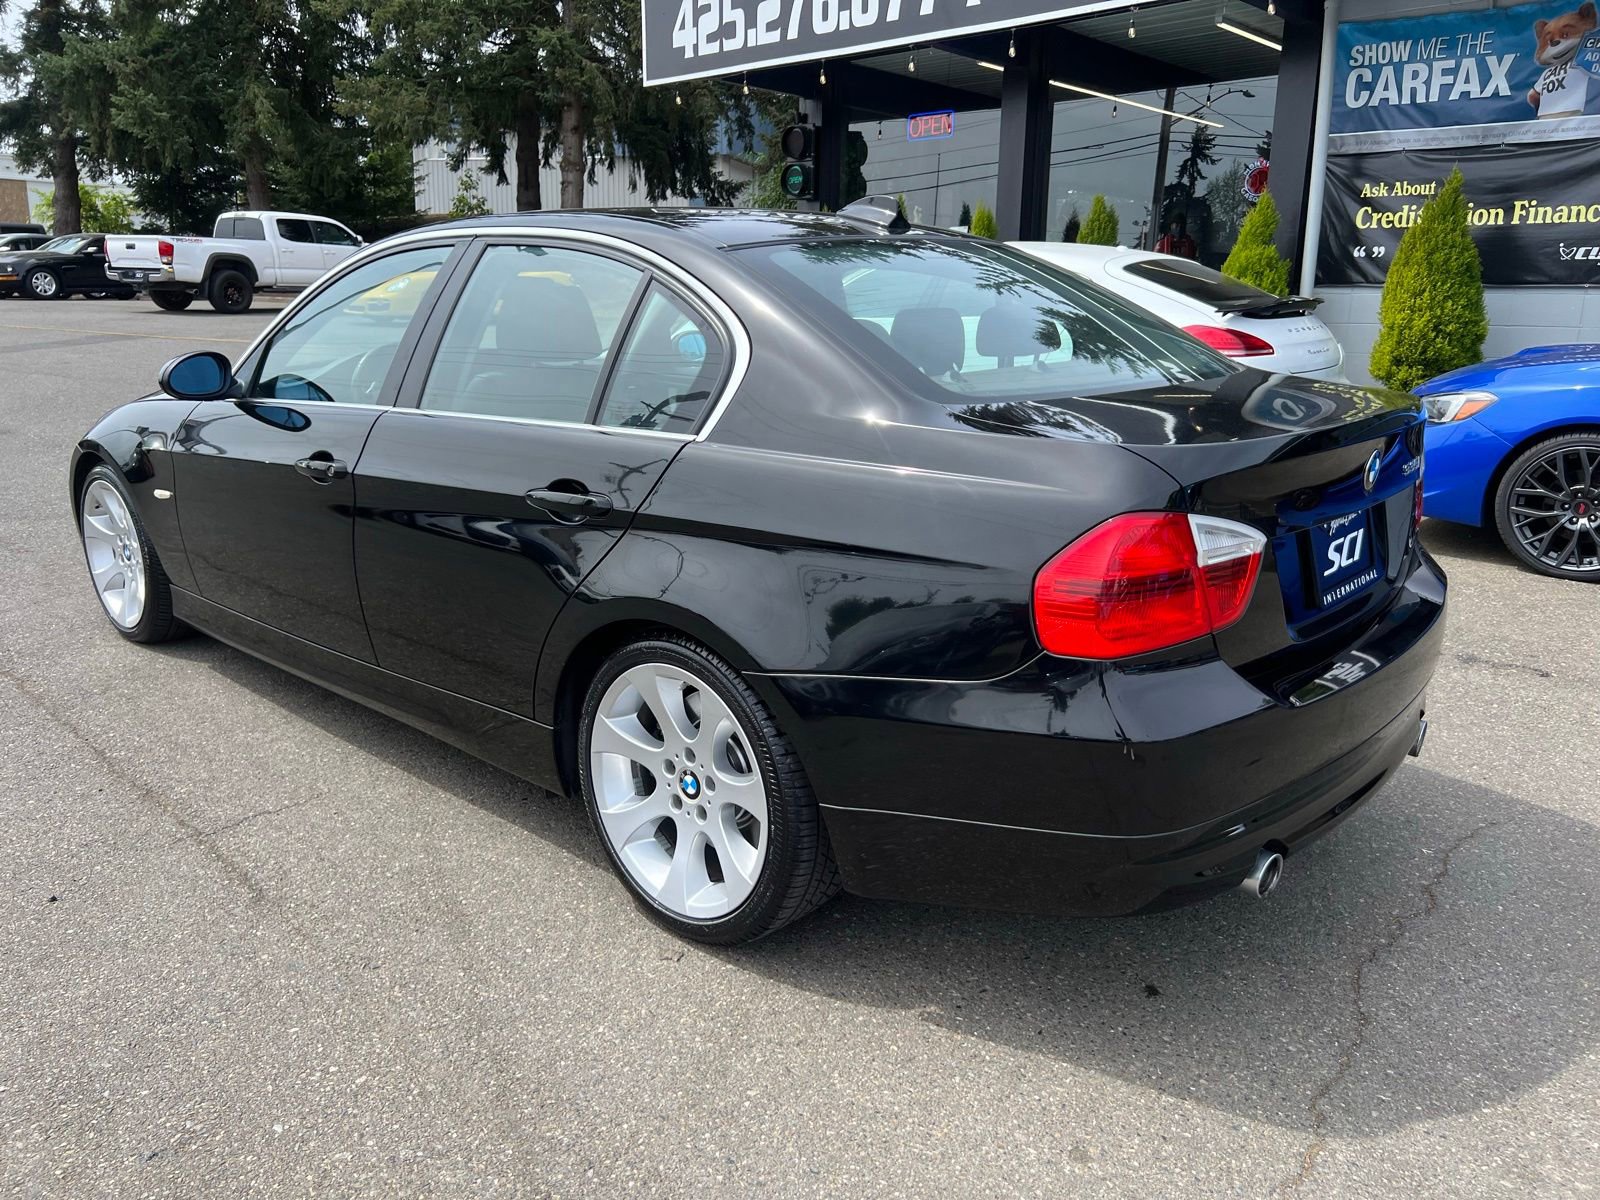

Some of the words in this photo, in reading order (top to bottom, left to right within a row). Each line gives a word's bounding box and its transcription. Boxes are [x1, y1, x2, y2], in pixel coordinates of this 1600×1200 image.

[1349, 40, 1413, 67] SHOW
[1417, 36, 1450, 60] ME
[1456, 31, 1495, 56] THE
[1345, 54, 1516, 109] CARFAX
[1541, 76, 1567, 96] FOX
[910, 114, 952, 137] OPEN
[1360, 183, 1389, 198] Ask
[1391, 181, 1436, 197] About
[1323, 527, 1364, 577] SCI
[1323, 568, 1378, 606] INTERNATIONAL
